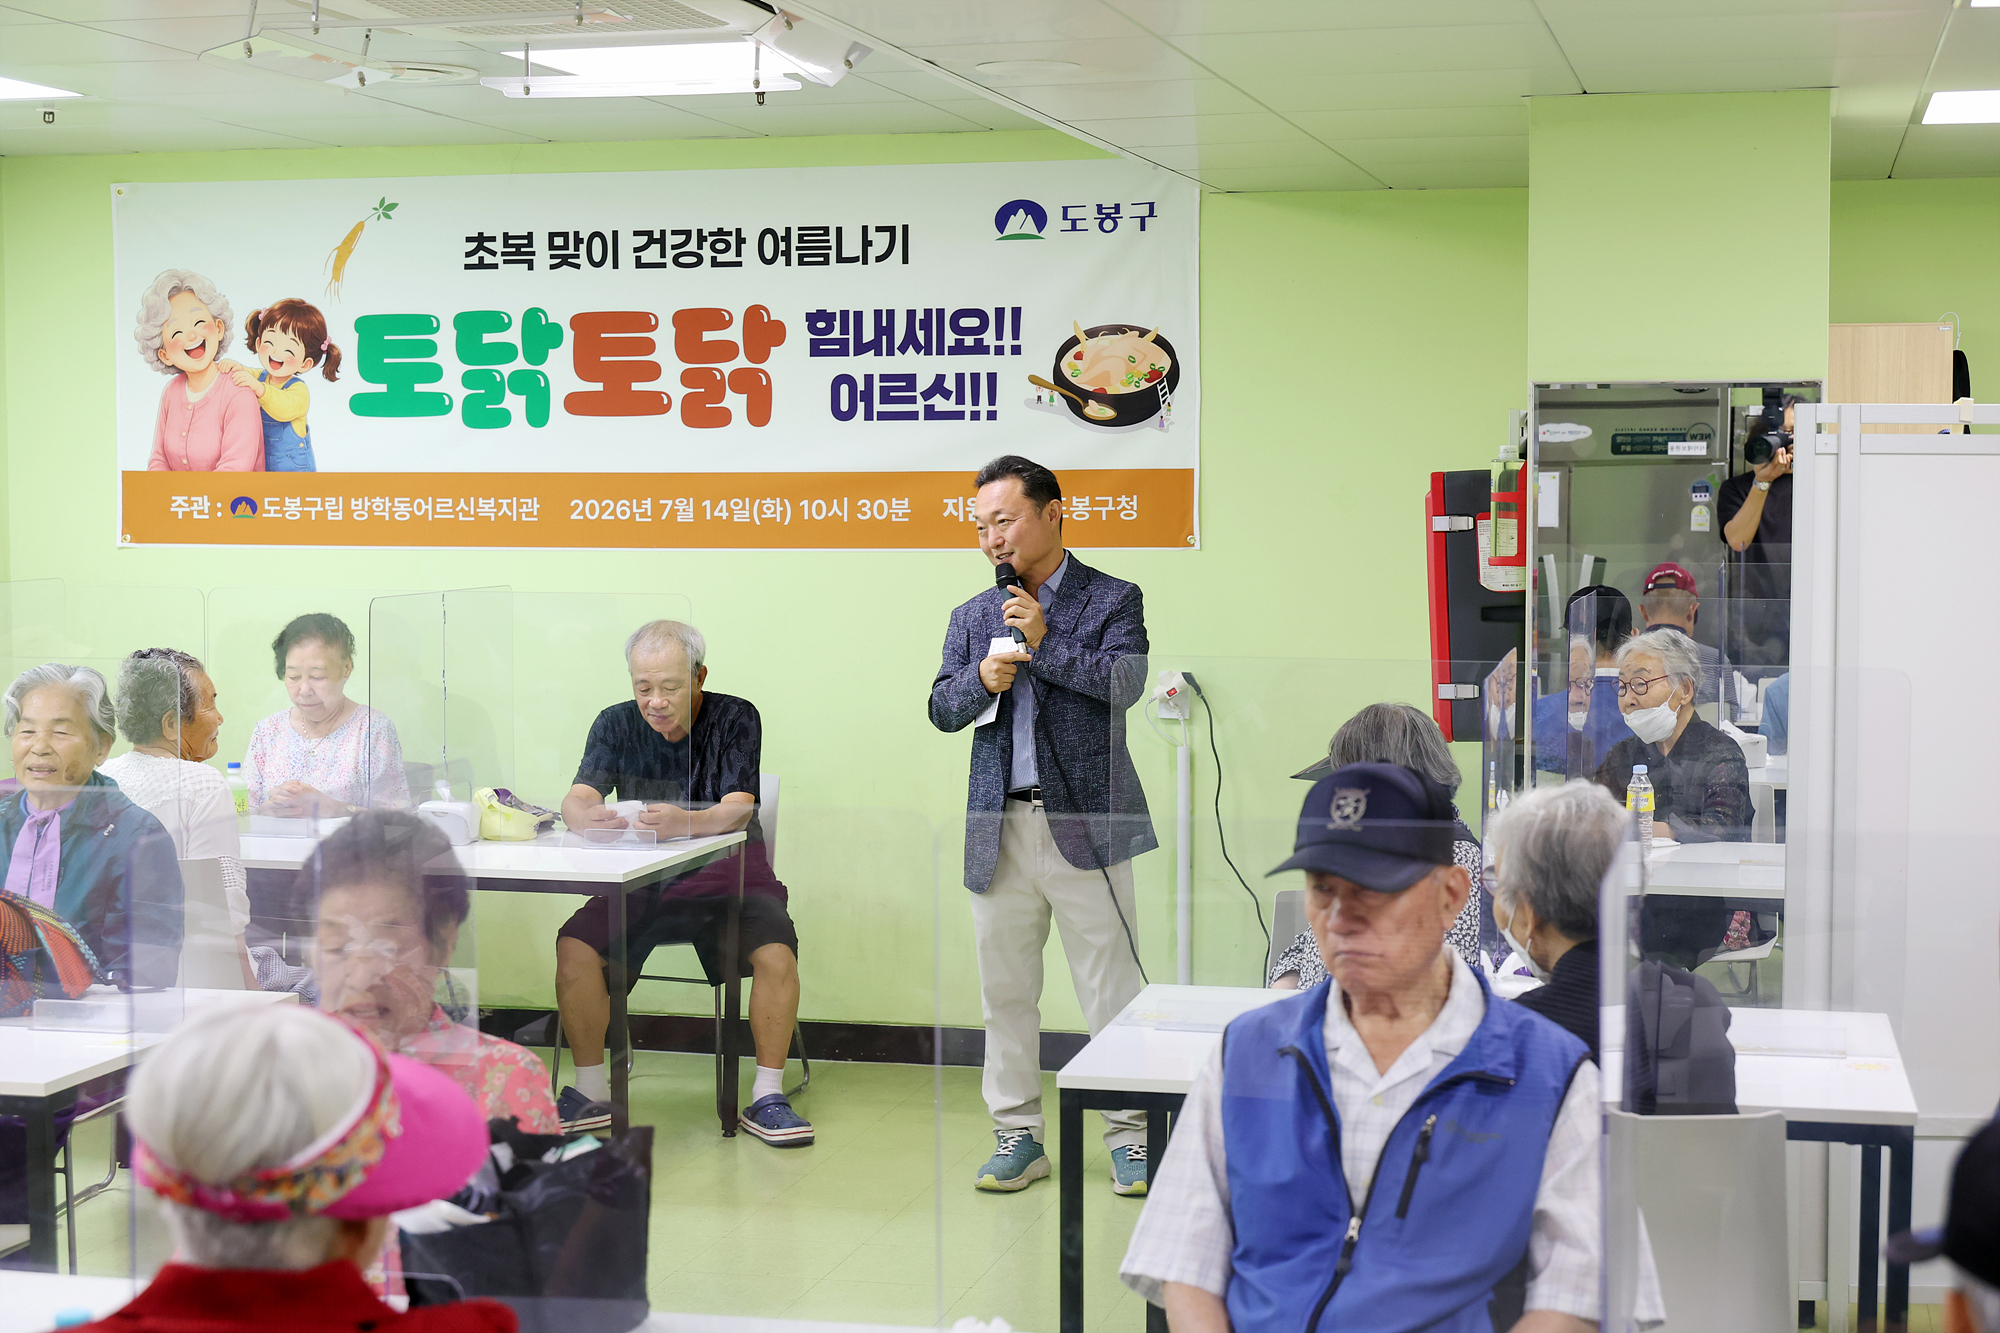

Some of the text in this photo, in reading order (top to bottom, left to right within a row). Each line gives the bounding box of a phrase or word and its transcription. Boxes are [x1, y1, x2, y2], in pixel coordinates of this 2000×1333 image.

[1060, 201, 1158, 234] 도봉구
[463, 224, 909, 271] 초복 맞이 건강한 여름나기
[805, 306, 1022, 358] 힘내세요!!
[349, 304, 787, 430] 토닭토닭
[830, 371, 998, 422] 어르신!!
[169, 494, 211, 520] 주관
[261, 495, 343, 521] 도봉구립
[350, 496, 541, 522] 방학동어르신복지관
[569, 496, 912, 526] 2026년 7월 14일(화) 10시 30분
[1061, 494, 1138, 521] 봉구청
